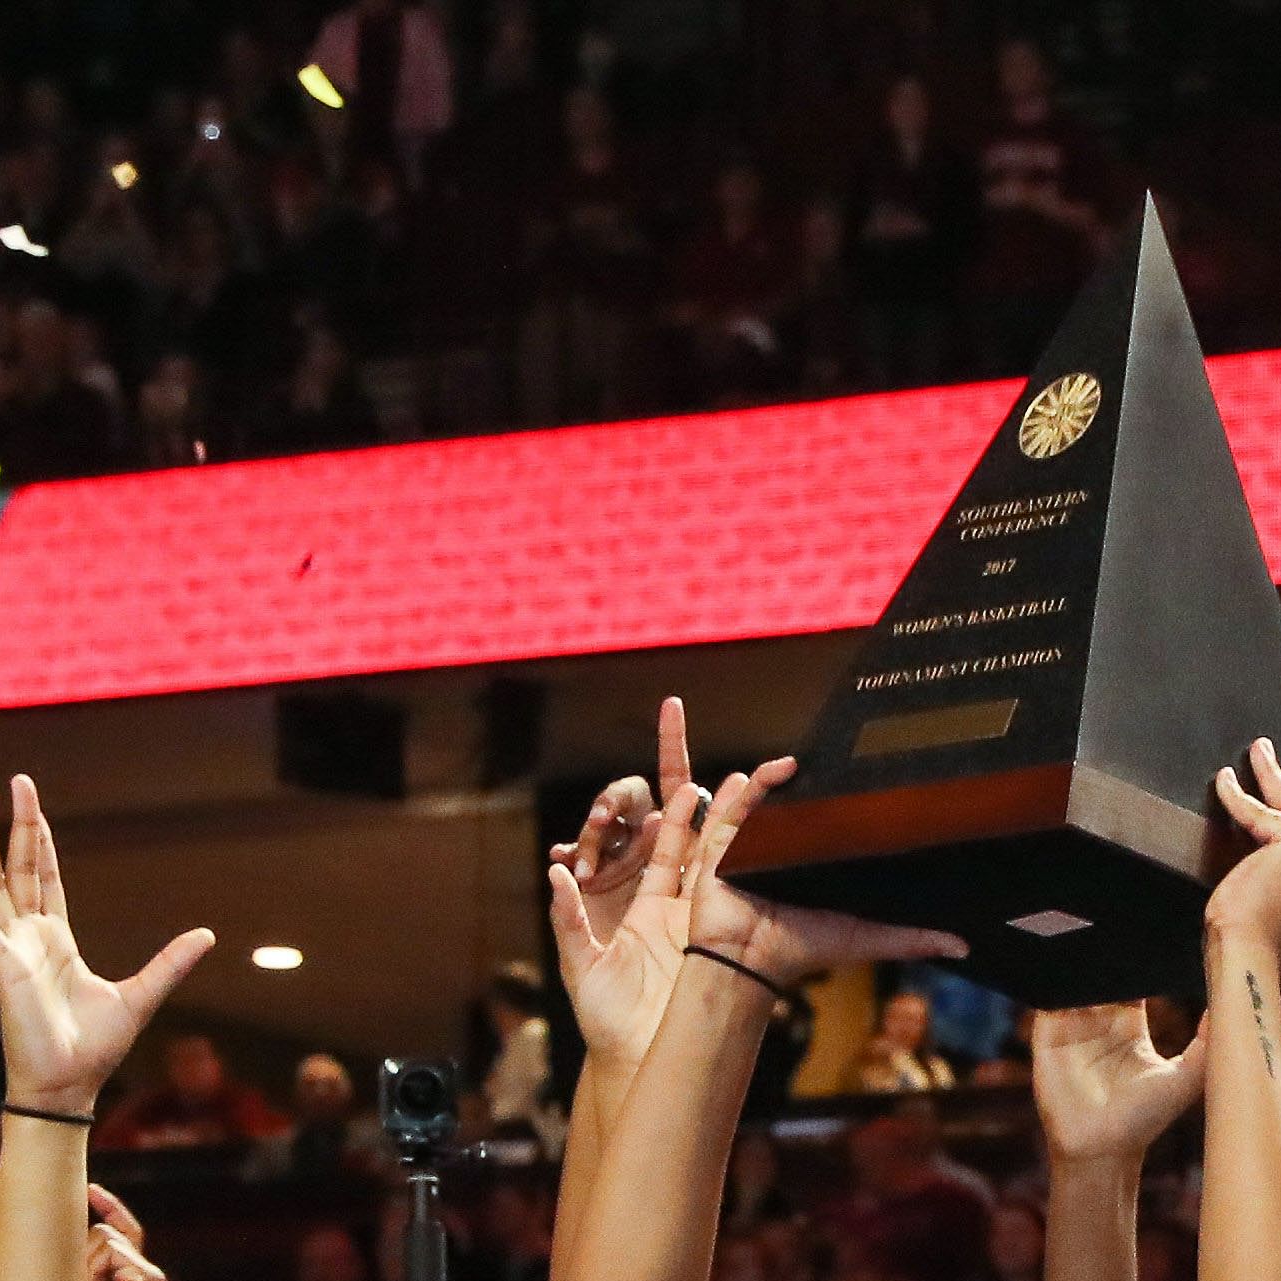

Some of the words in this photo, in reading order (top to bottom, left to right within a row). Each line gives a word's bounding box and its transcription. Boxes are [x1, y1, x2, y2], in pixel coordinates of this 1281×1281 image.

[957, 490, 1089, 525] SOUTHEASTERN
[960, 511, 1071, 541] CONFERENCE
[981, 558, 1017, 577] 2017
[893, 613, 964, 638] WOMEN'S
[967, 598, 1067, 625] BASKETBALL
[856, 661, 968, 691] TOURNAMENT
[972, 648, 1063, 672] CHAMPION
